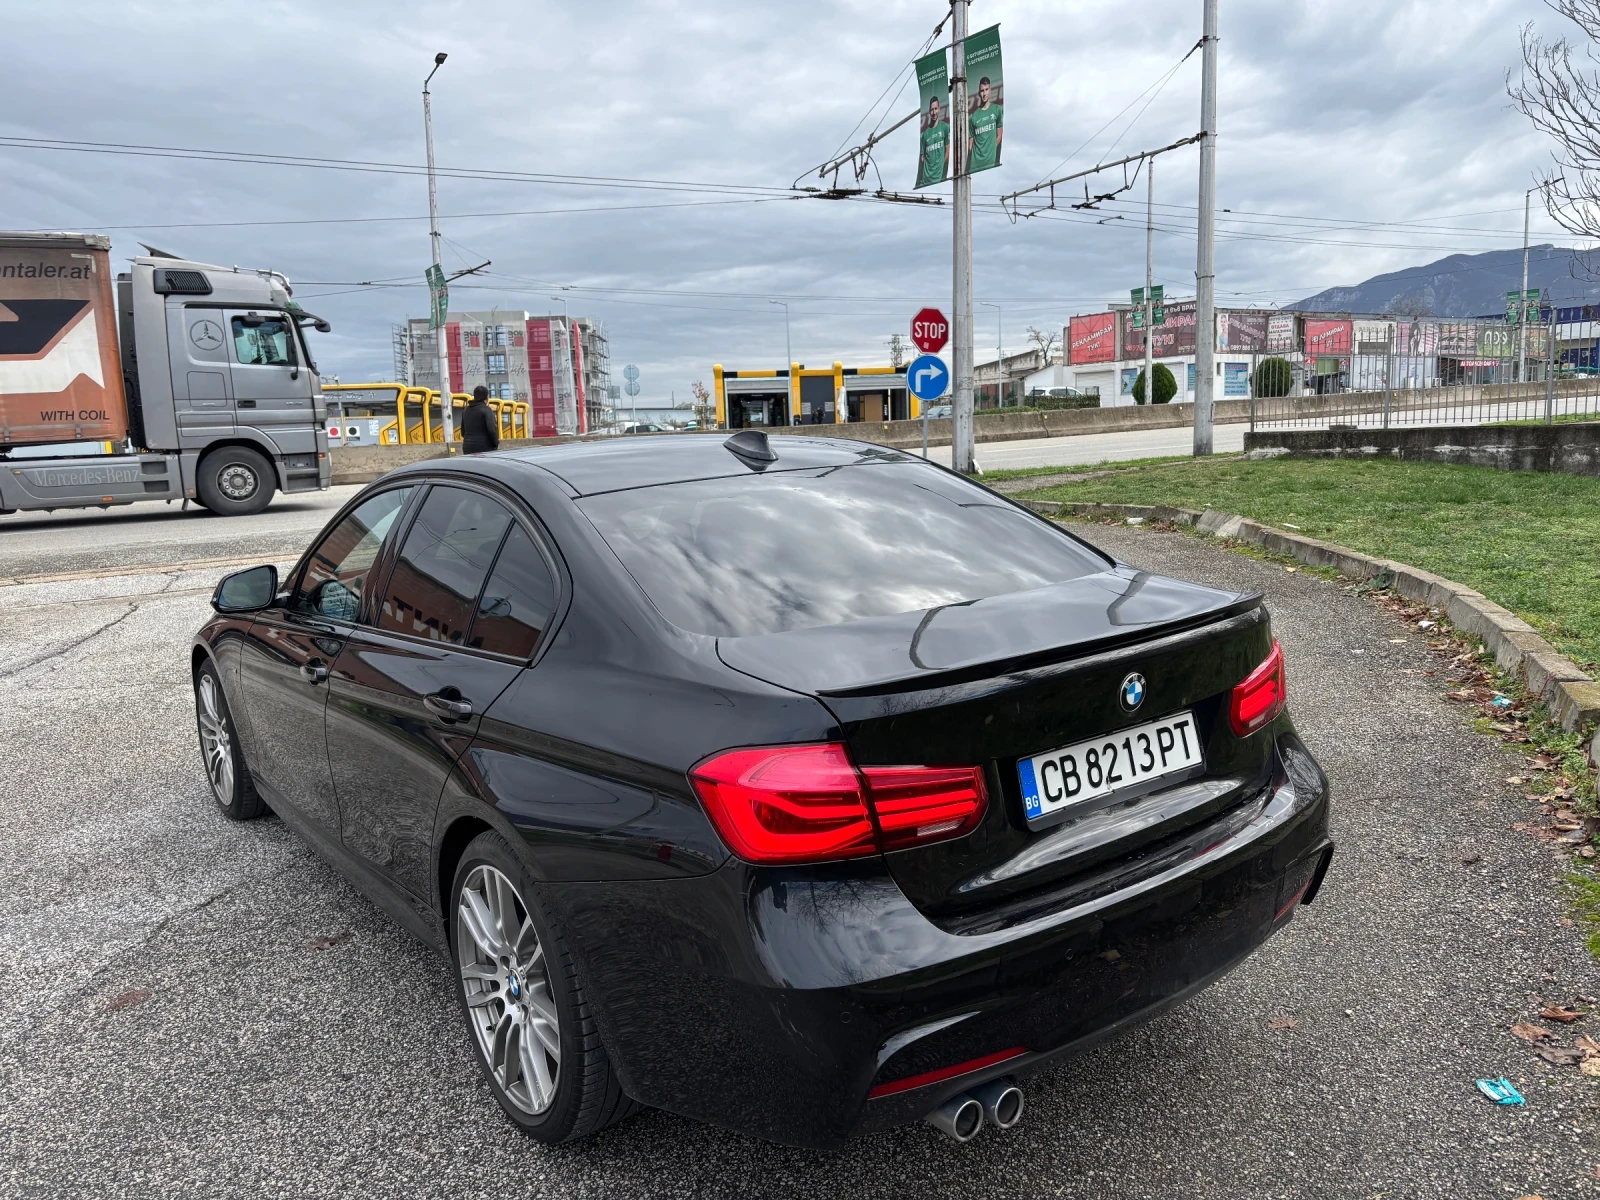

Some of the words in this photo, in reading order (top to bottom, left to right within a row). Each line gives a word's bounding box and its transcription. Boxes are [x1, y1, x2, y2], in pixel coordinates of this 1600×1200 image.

[975, 122, 996, 135] WINBET
[926, 140, 944, 152] WINBET
[0, 262, 91, 280] ntaler.at
[914, 321, 946, 339] STOP
[1071, 324, 1113, 349] РЕКЛАМИРАЙ
[1087, 341, 1101, 351] ТУК!
[1152, 333, 1175, 346] ТУК!
[40, 410, 75, 421] WITH
[78, 409, 110, 421] COIL
[34, 466, 139, 487] Mercedes-Benz
[1041, 754, 1082, 803] CB
[1086, 732, 1155, 789] 8213
[1155, 719, 1191, 768] PT
[1025, 795, 1039, 810] BG
